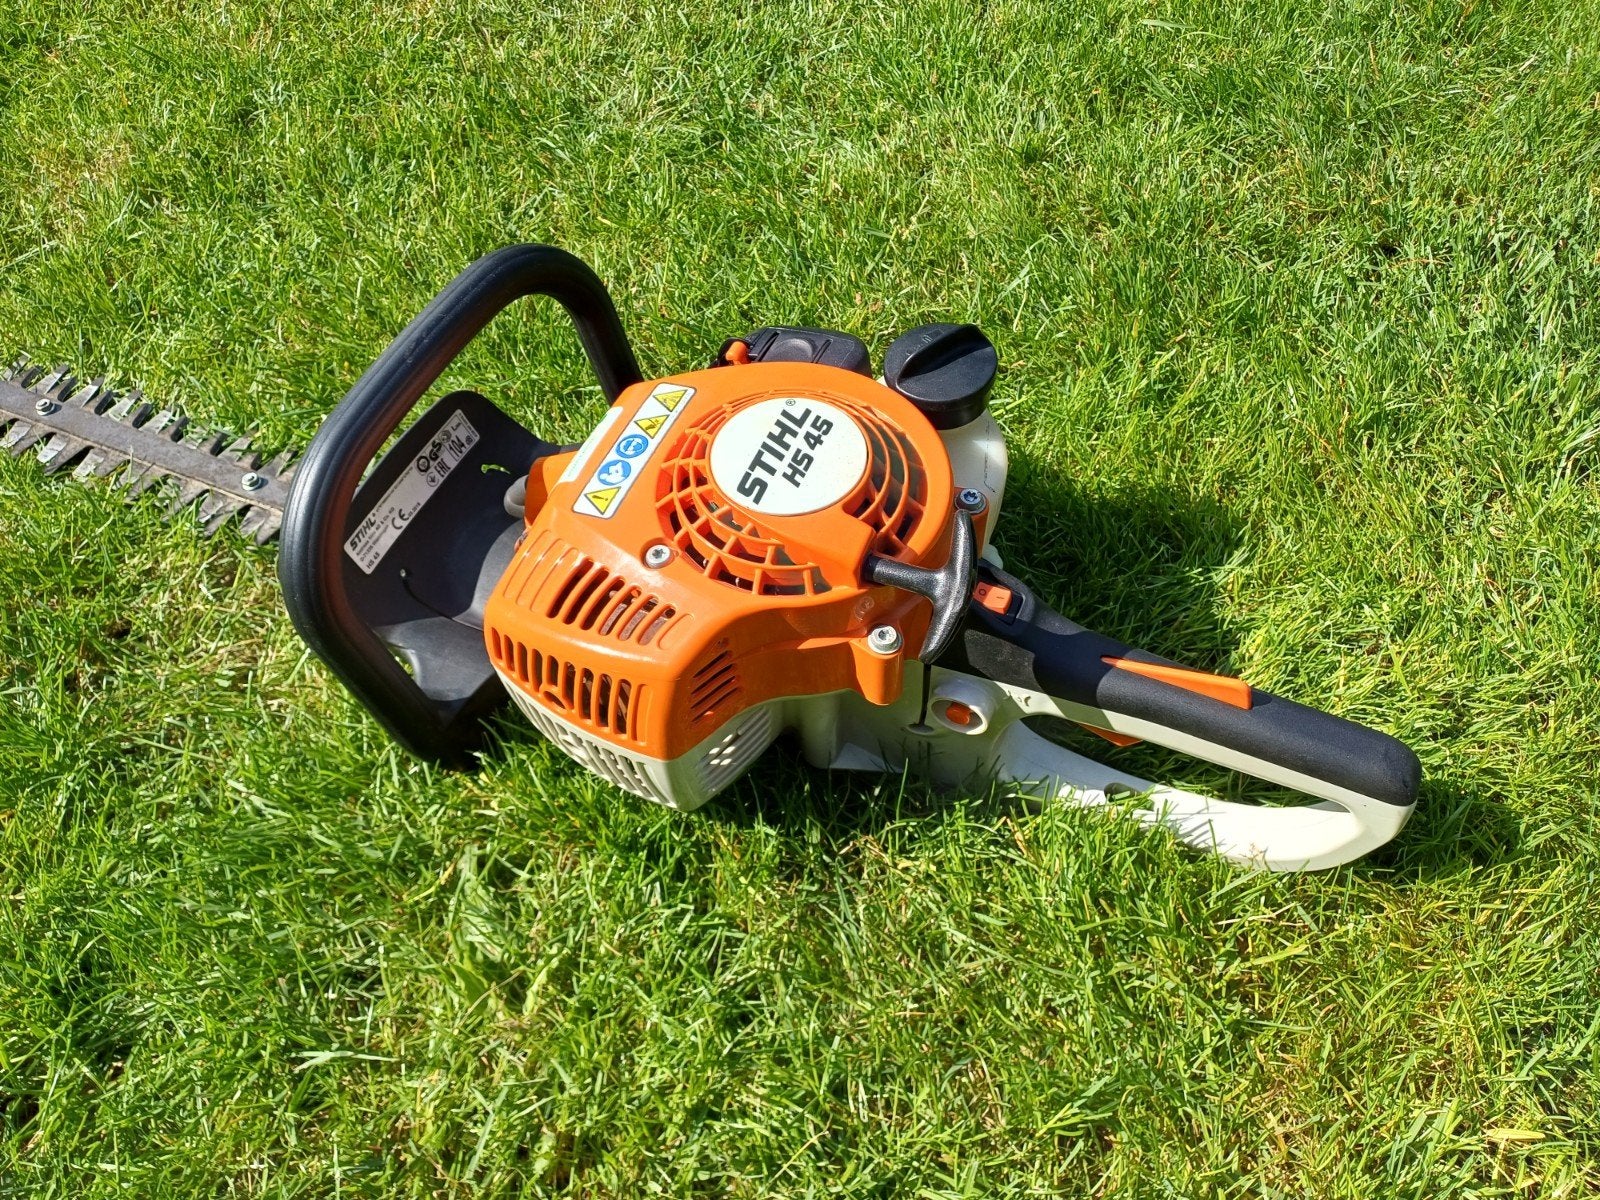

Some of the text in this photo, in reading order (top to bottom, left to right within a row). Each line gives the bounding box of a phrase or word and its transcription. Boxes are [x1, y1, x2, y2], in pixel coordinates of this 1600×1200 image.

[448, 435, 467, 458] 104
[736, 408, 812, 505] STIHL
[781, 414, 834, 488] HS 45
[349, 518, 376, 551] STIHL
